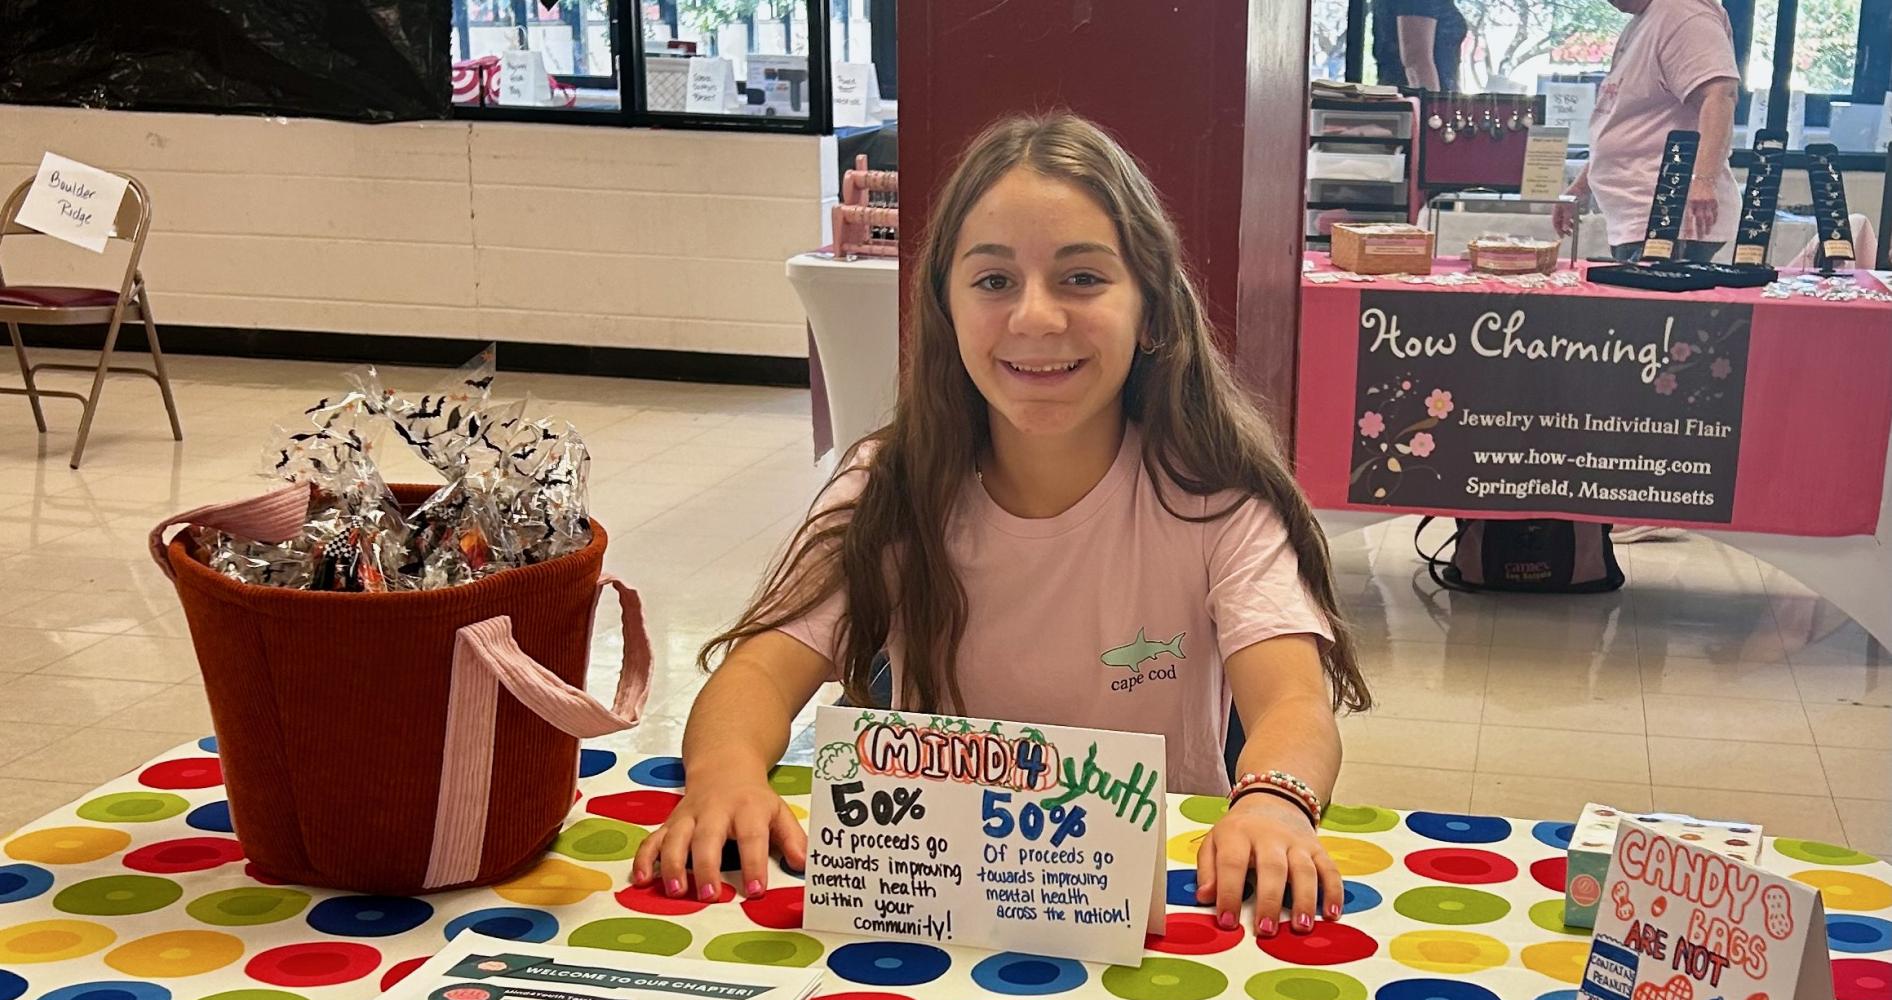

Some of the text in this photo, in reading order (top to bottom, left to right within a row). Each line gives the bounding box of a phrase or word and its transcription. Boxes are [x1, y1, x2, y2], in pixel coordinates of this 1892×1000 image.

[48, 170, 96, 199] Boulder
[58, 199, 92, 227] Ridge
[1361, 308, 1675, 384] How Charming!
[1459, 409, 1732, 439] Jewelry with Individual Flair
[1473, 447, 1712, 476] www.how-charming.com
[1466, 476, 1715, 507] Springfield, Massachusetts
[1111, 664, 1177, 692] cape cod
[872, 725, 1009, 783] MIND
[1015, 740, 1048, 790] 4
[830, 780, 926, 827] 50%
[982, 789, 1087, 848] 50%
[851, 832, 919, 853] proceeds
[926, 837, 948, 859] go
[1019, 847, 1084, 865] proceeds
[1093, 852, 1114, 870] go
[810, 849, 962, 886] towards improving
[976, 866, 1108, 891] towards improving
[1619, 829, 1760, 925] CANDY
[812, 873, 937, 898] mental health
[986, 887, 1089, 905] mental health
[810, 892, 914, 918] within your
[1043, 908, 1066, 921] the
[1074, 898, 1131, 929] nation!
[854, 909, 953, 942] community!
[1624, 919, 1731, 988] ARE NOT
[1688, 908, 1768, 981] BAGS
[526, 965, 754, 997] WELCOME TO OUR CHAPTER!
